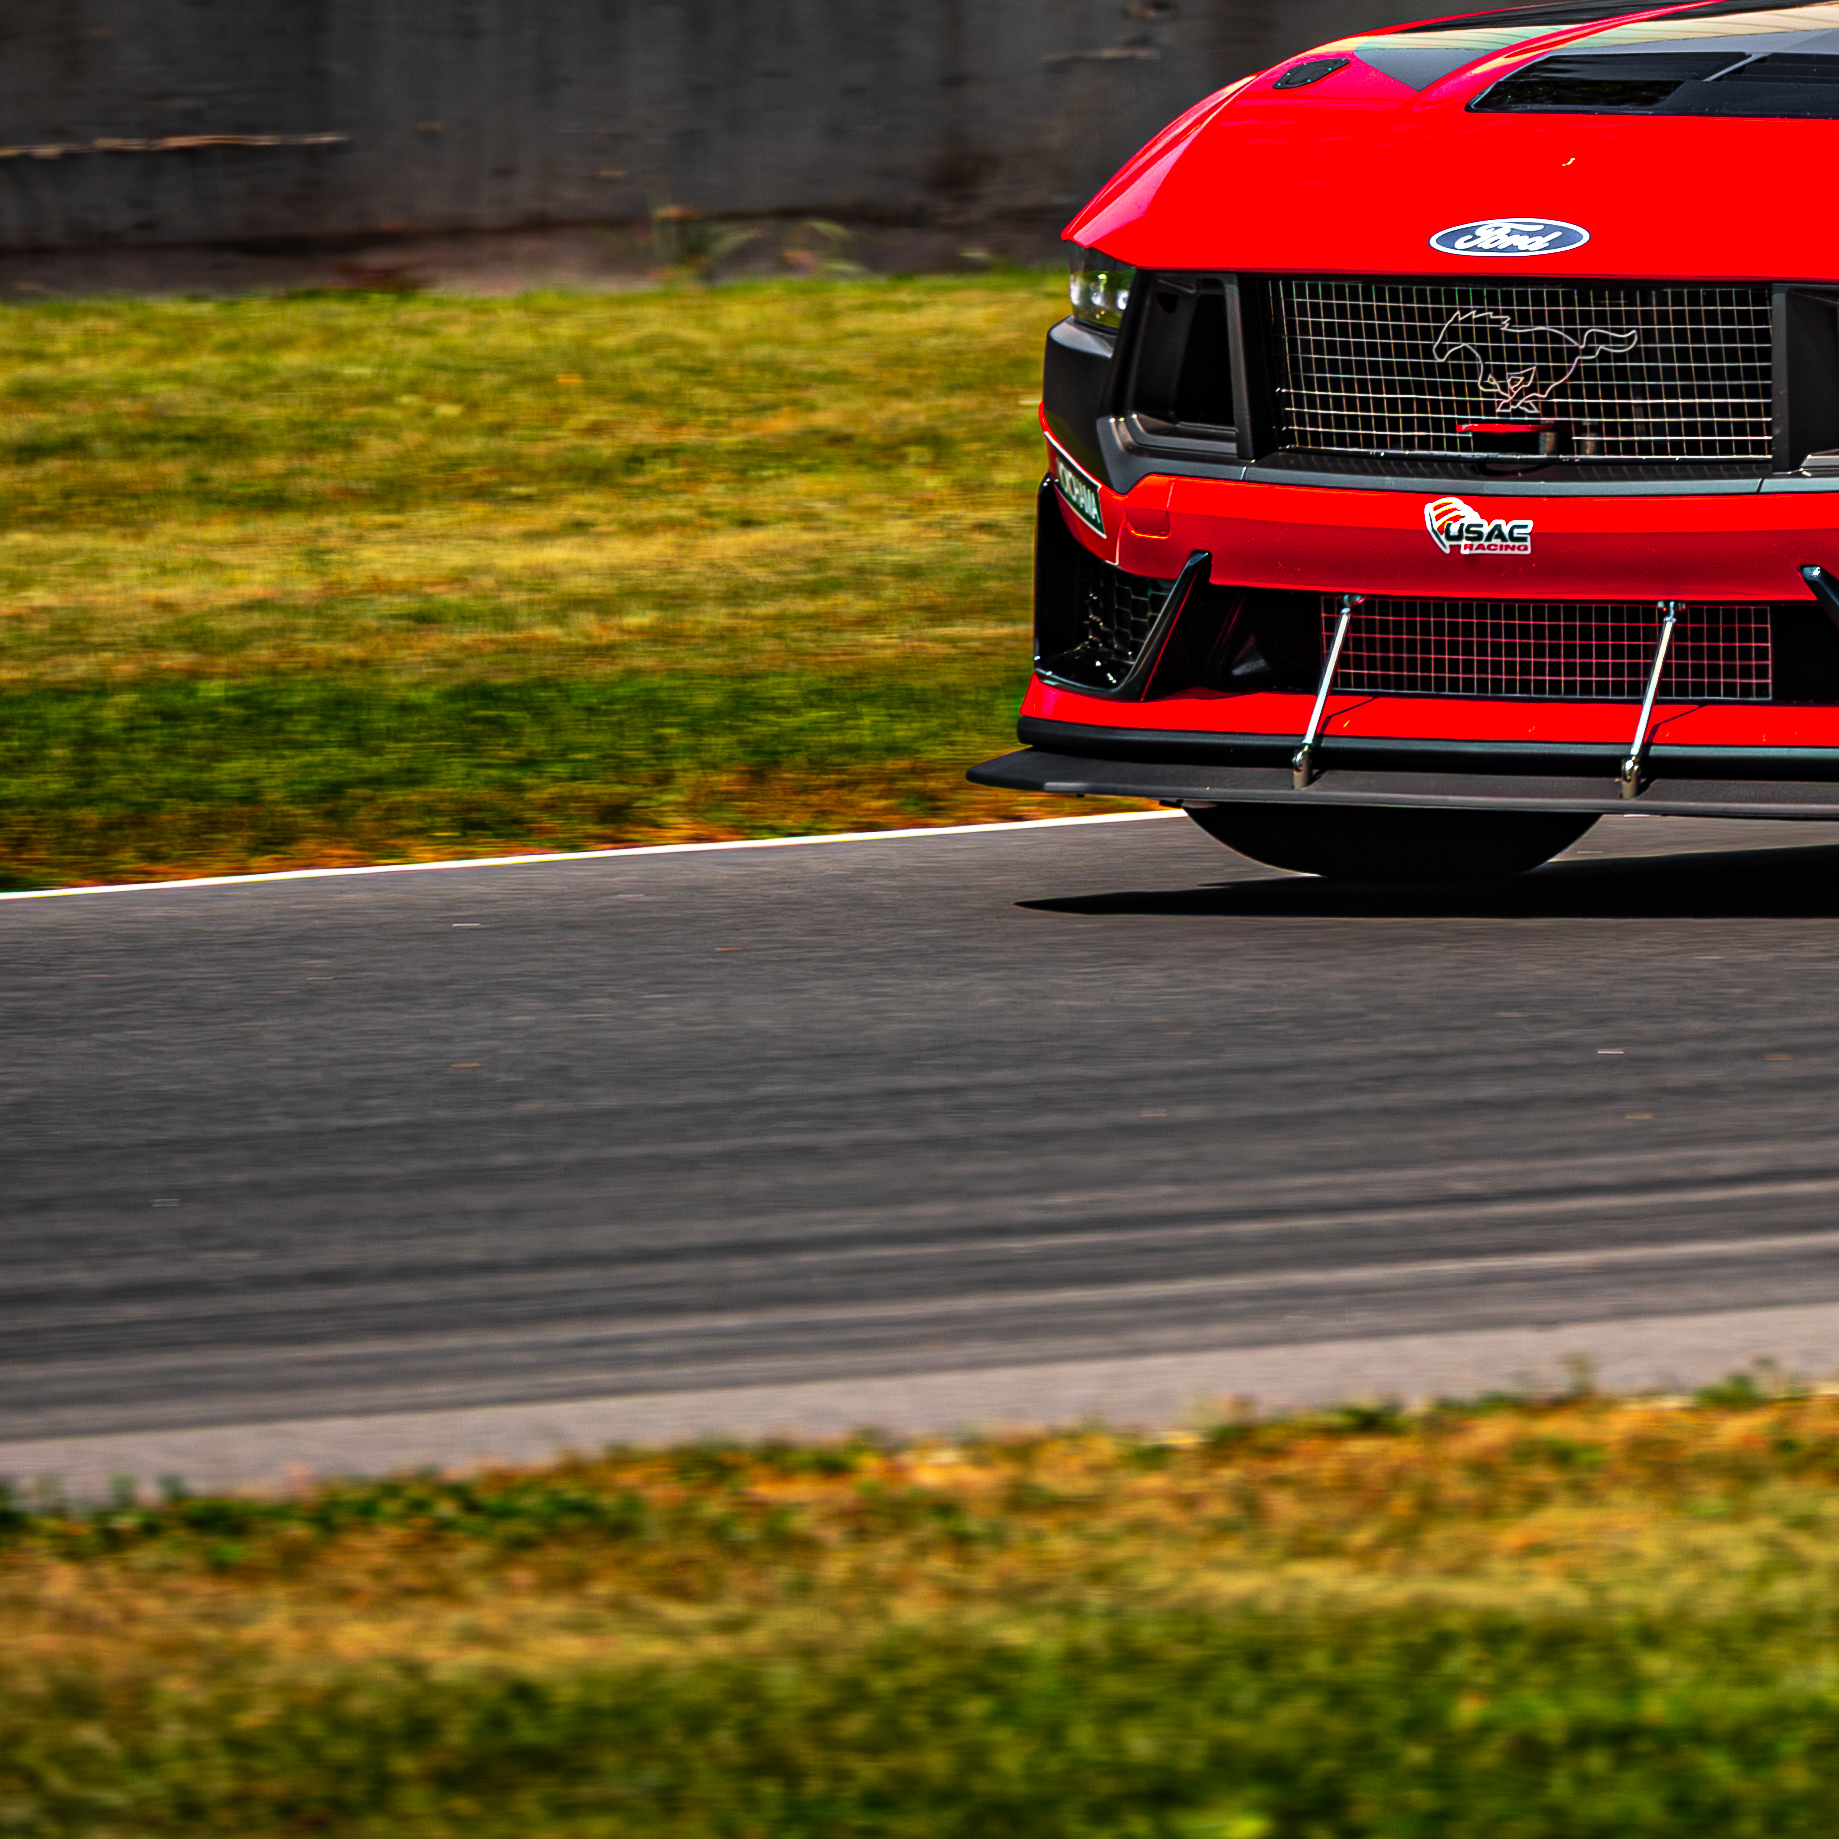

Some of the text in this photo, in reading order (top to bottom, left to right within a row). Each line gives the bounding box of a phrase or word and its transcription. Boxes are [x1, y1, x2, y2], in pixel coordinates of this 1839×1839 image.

[1454, 221, 1563, 252] Ford
[1444, 521, 1531, 543] USAC
[1463, 542, 1530, 553] RACING
